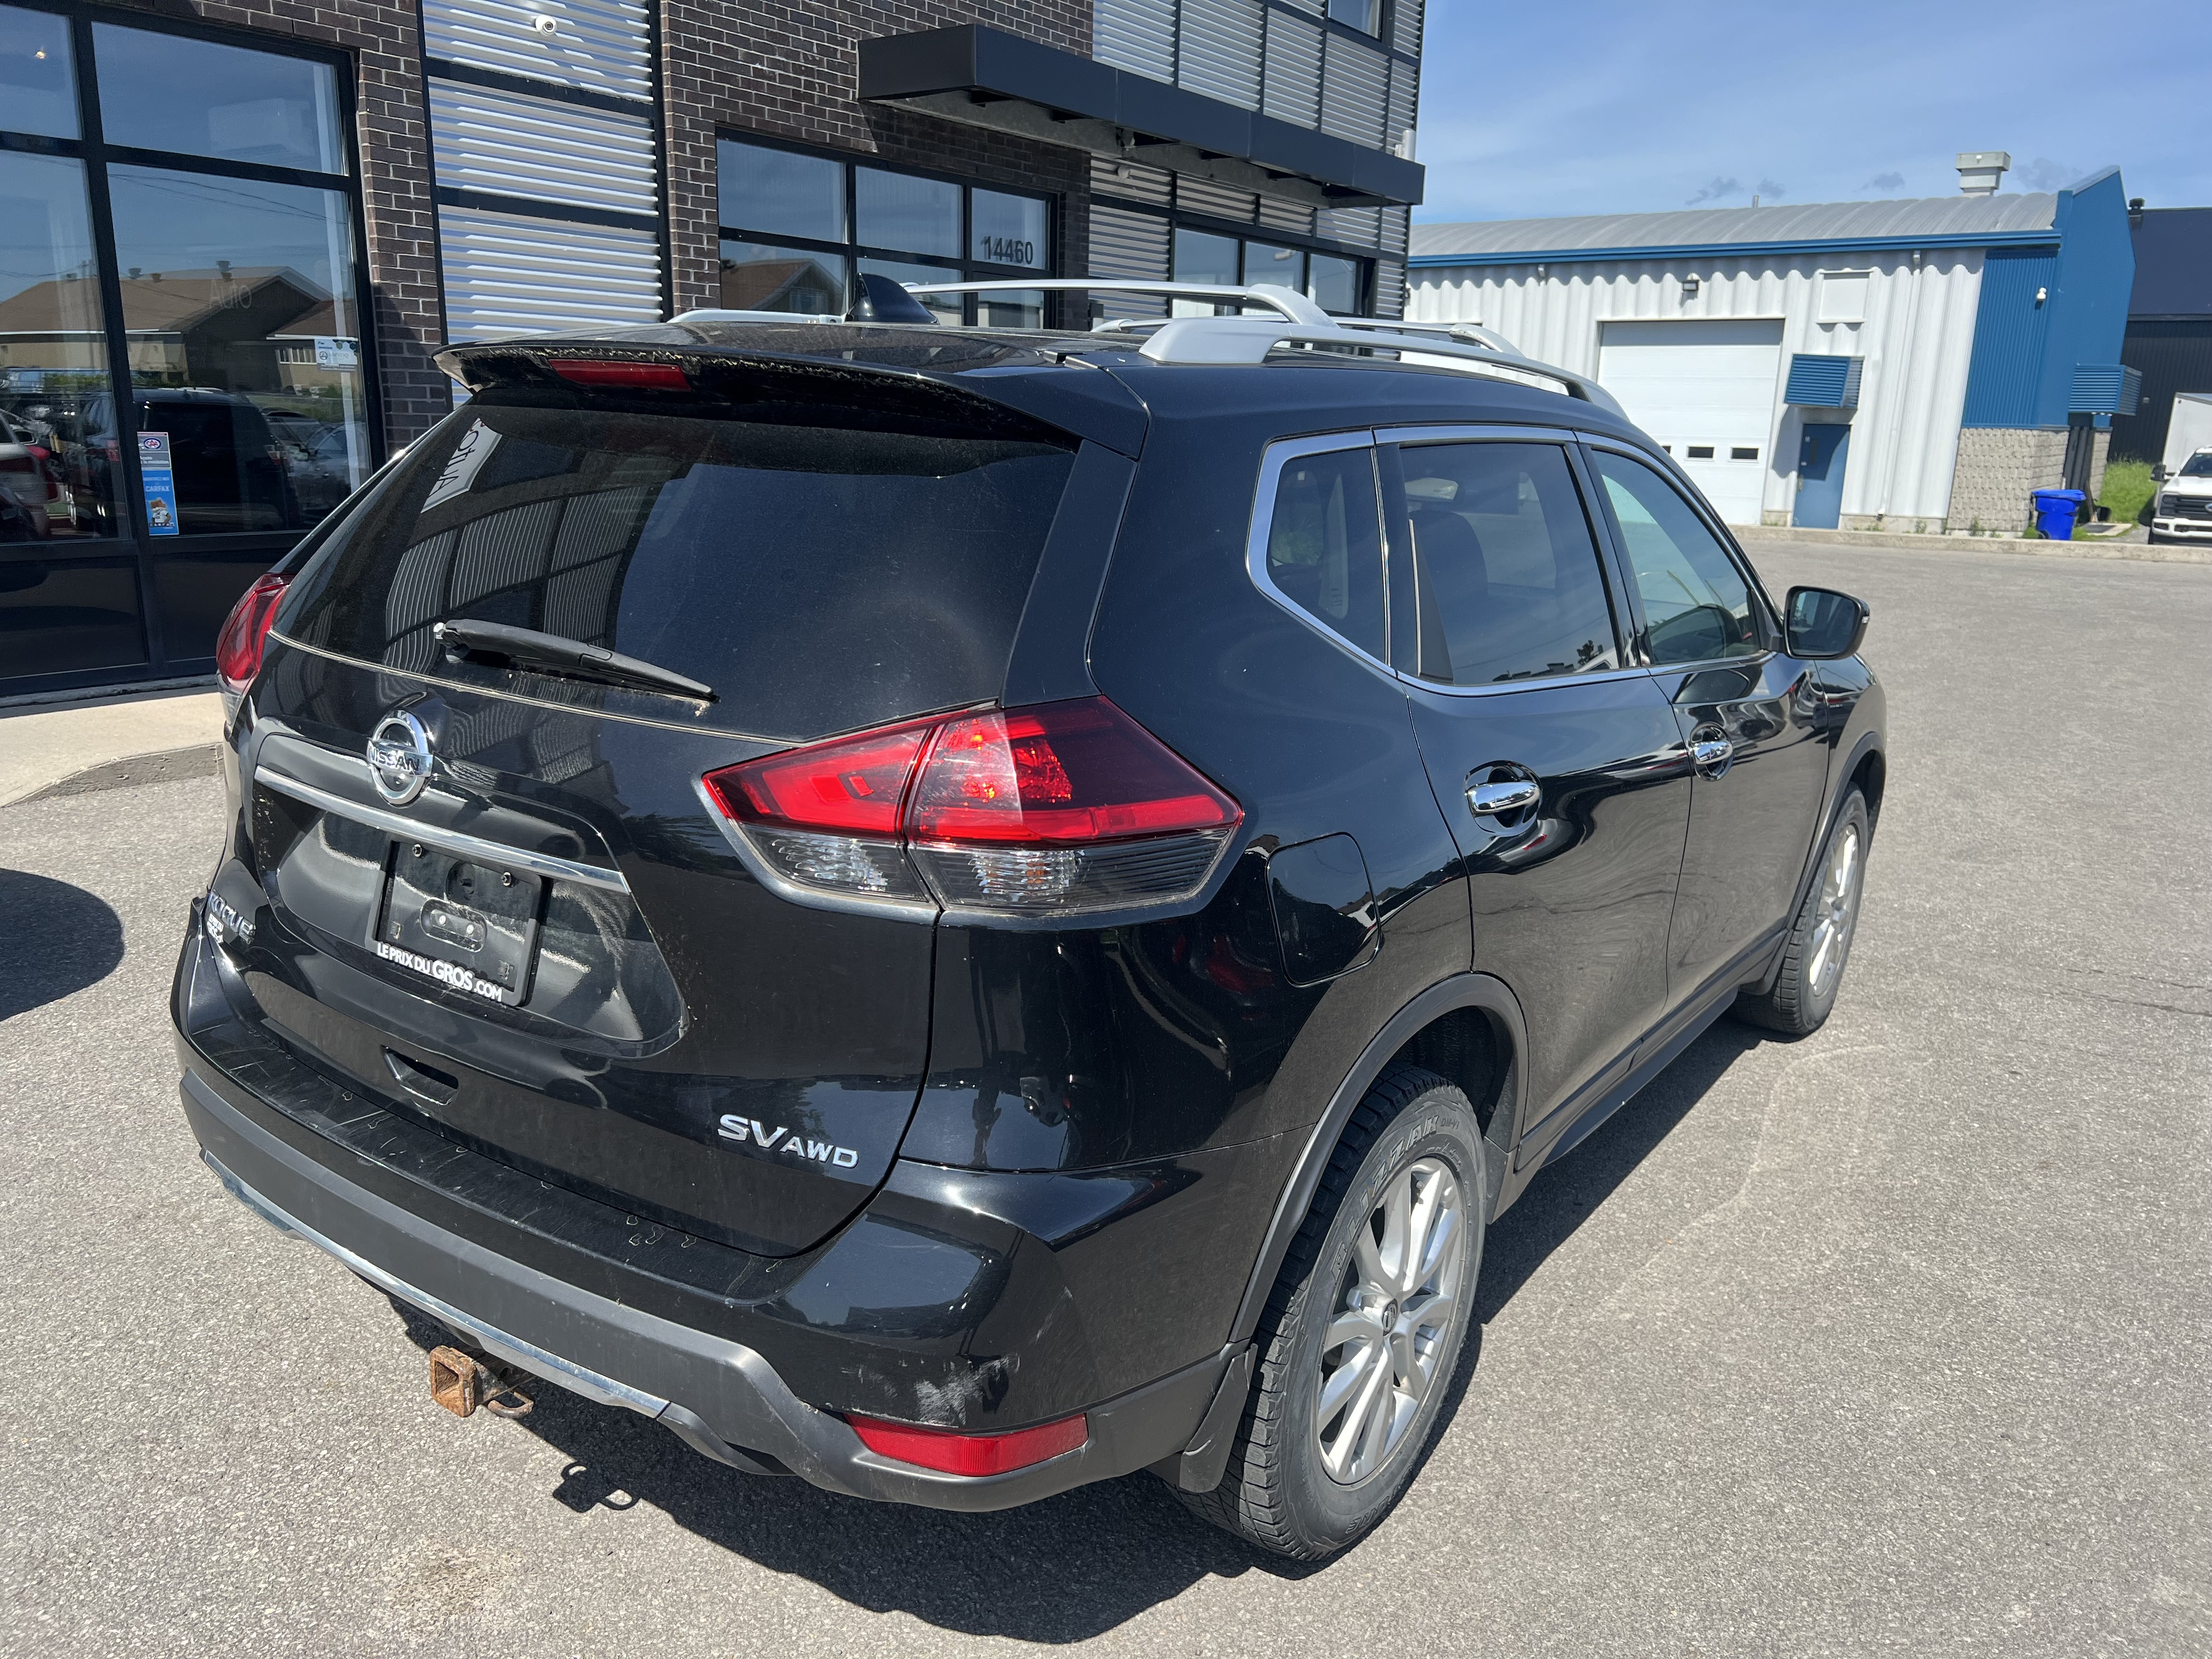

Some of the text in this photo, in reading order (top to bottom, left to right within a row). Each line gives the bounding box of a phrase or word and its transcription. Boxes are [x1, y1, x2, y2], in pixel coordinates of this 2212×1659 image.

[983, 236, 1033, 264] 14460
[208, 280, 252, 309] Auto
[368, 746, 420, 772] NISSAN
[208, 889, 256, 945] ROGUE
[377, 943, 389, 959] LE
[389, 947, 414, 968] PRIX
[414, 956, 431, 974] DU
[717, 1114, 859, 1169] SV AWD
[1330, 1115, 1439, 1282] BLIZZAK
